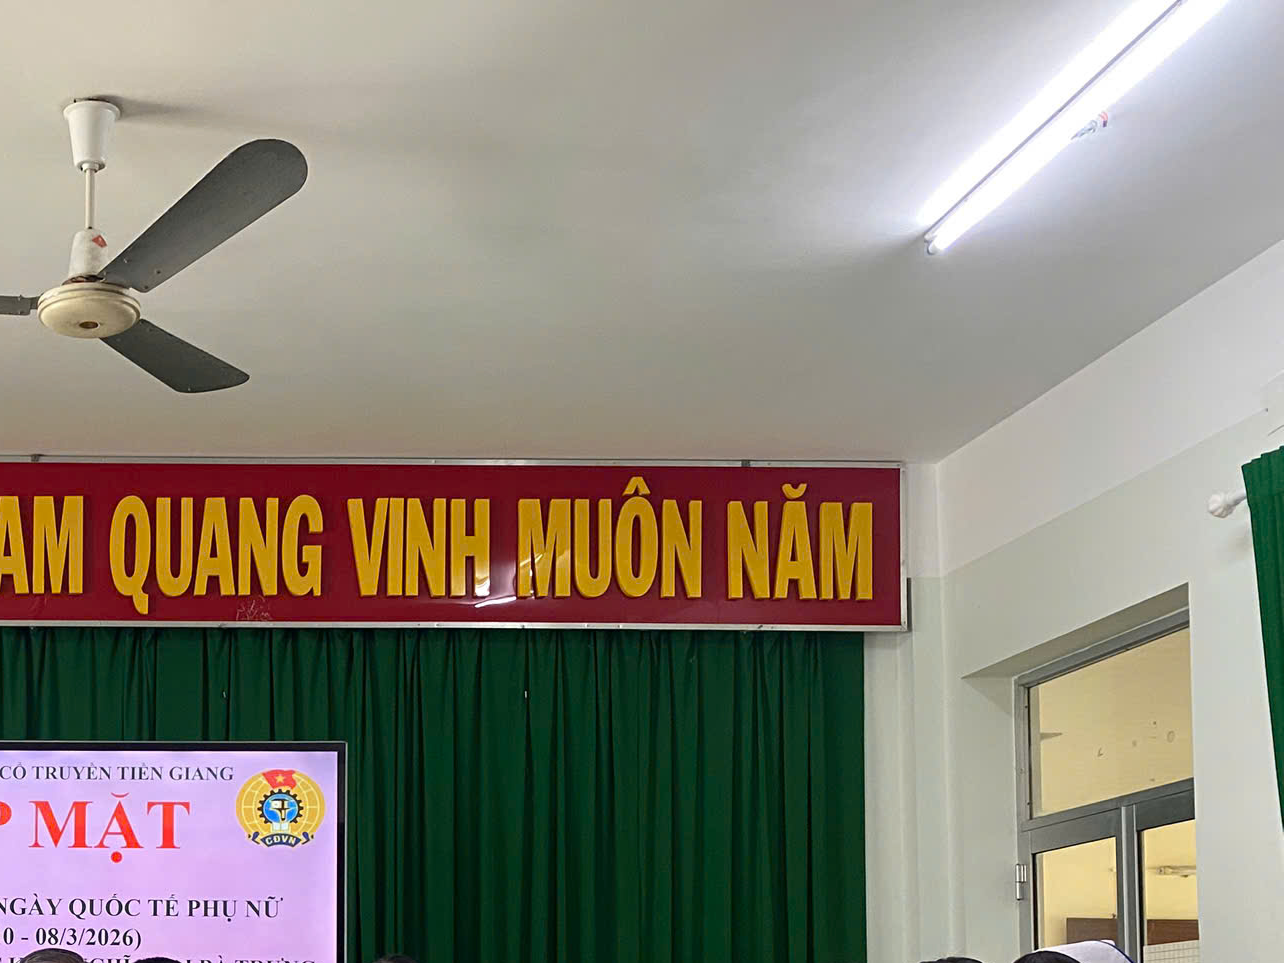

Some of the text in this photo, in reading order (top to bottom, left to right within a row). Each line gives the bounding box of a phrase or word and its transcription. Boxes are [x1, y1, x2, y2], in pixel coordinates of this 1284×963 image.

[109, 494, 323, 615] QUANG
[346, 497, 491, 598] VINH
[517, 476, 703, 600] MUÔN
[727, 483, 874, 600] NĂM
[32, 763, 111, 780] TRUYỀN
[116, 762, 163, 780] TIỀN
[169, 765, 234, 781] GIANG
[28, 791, 191, 863] MẶT
[68, 893, 141, 918] QUỐC
[148, 893, 179, 916] TẾ
[187, 898, 237, 923] PHỤ
[245, 896, 285, 918] NỮ
[35, 927, 142, 950] 08/3/2026)
